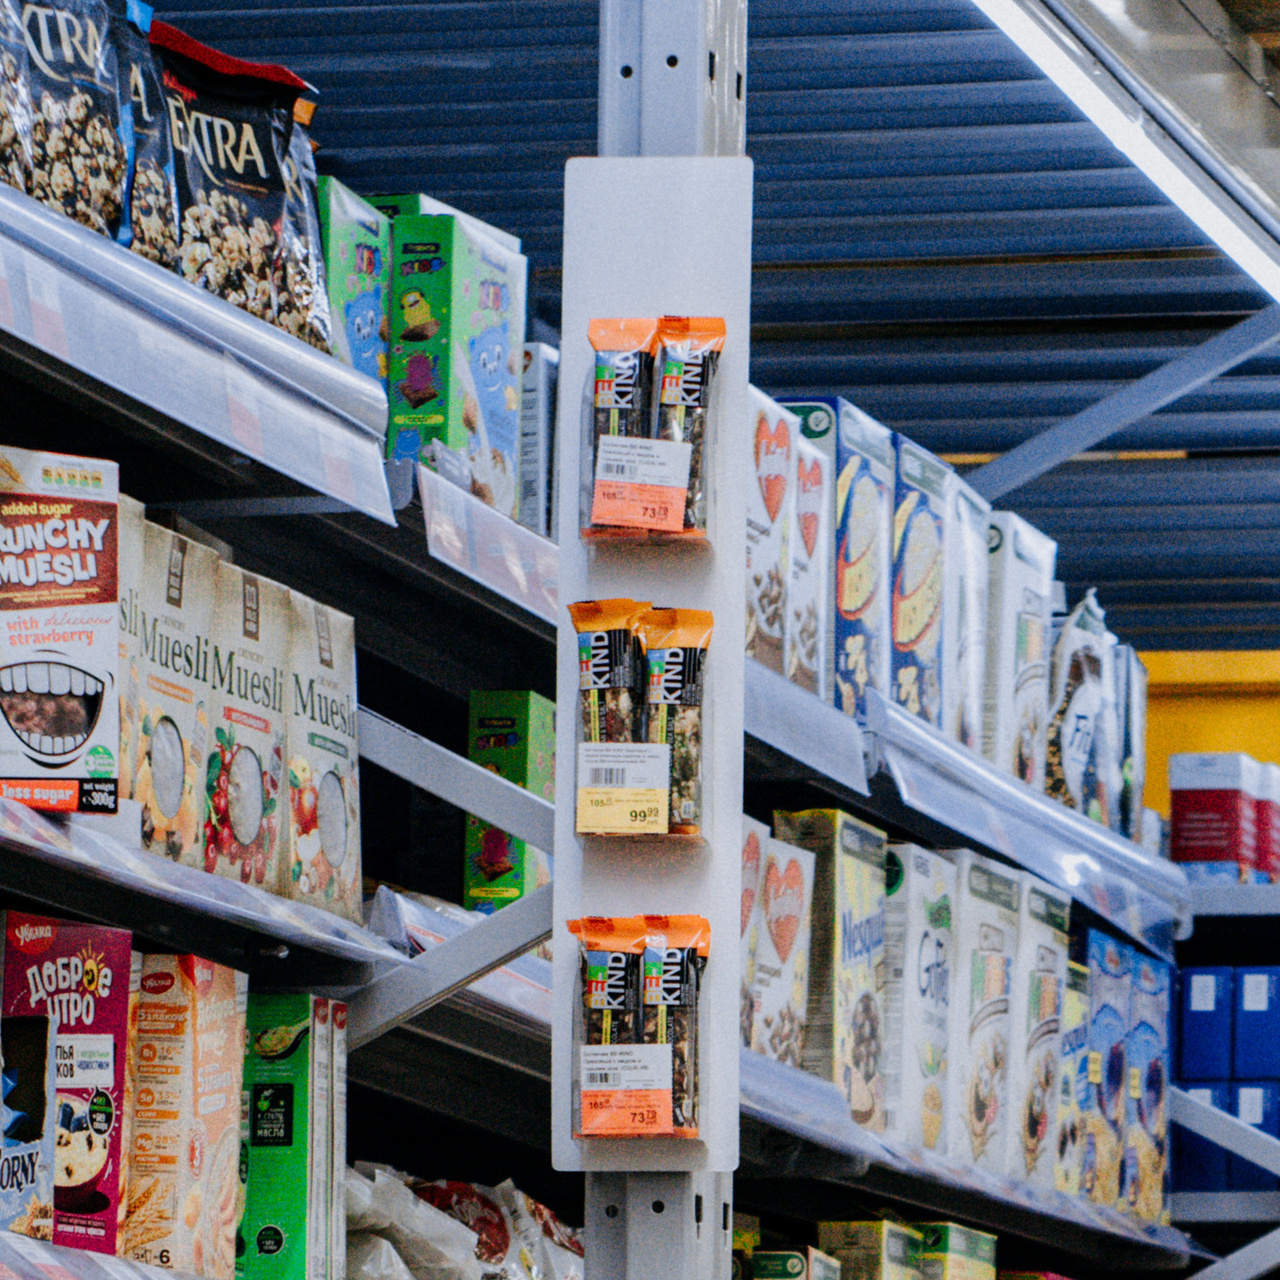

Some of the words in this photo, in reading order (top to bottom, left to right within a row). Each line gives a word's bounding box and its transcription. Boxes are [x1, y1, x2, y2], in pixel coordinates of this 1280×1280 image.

[165, 94, 268, 188] EXTRA
[7, 617, 39, 631] with
[8, 631, 94, 646] strawberry
[140, 611, 209, 683] Muesli
[211, 645, 284, 714] Muesli
[591, 631, 610, 688] KIND
[662, 647, 685, 704] KIND
[34, 788, 73, 806] sugar
[629, 810, 647, 822] 99
[606, 952, 627, 1009] KIND
[661, 948, 682, 1004] KIND
[630, 1112, 645, 1124] 73
[0, 1151, 39, 1192] ORNY
